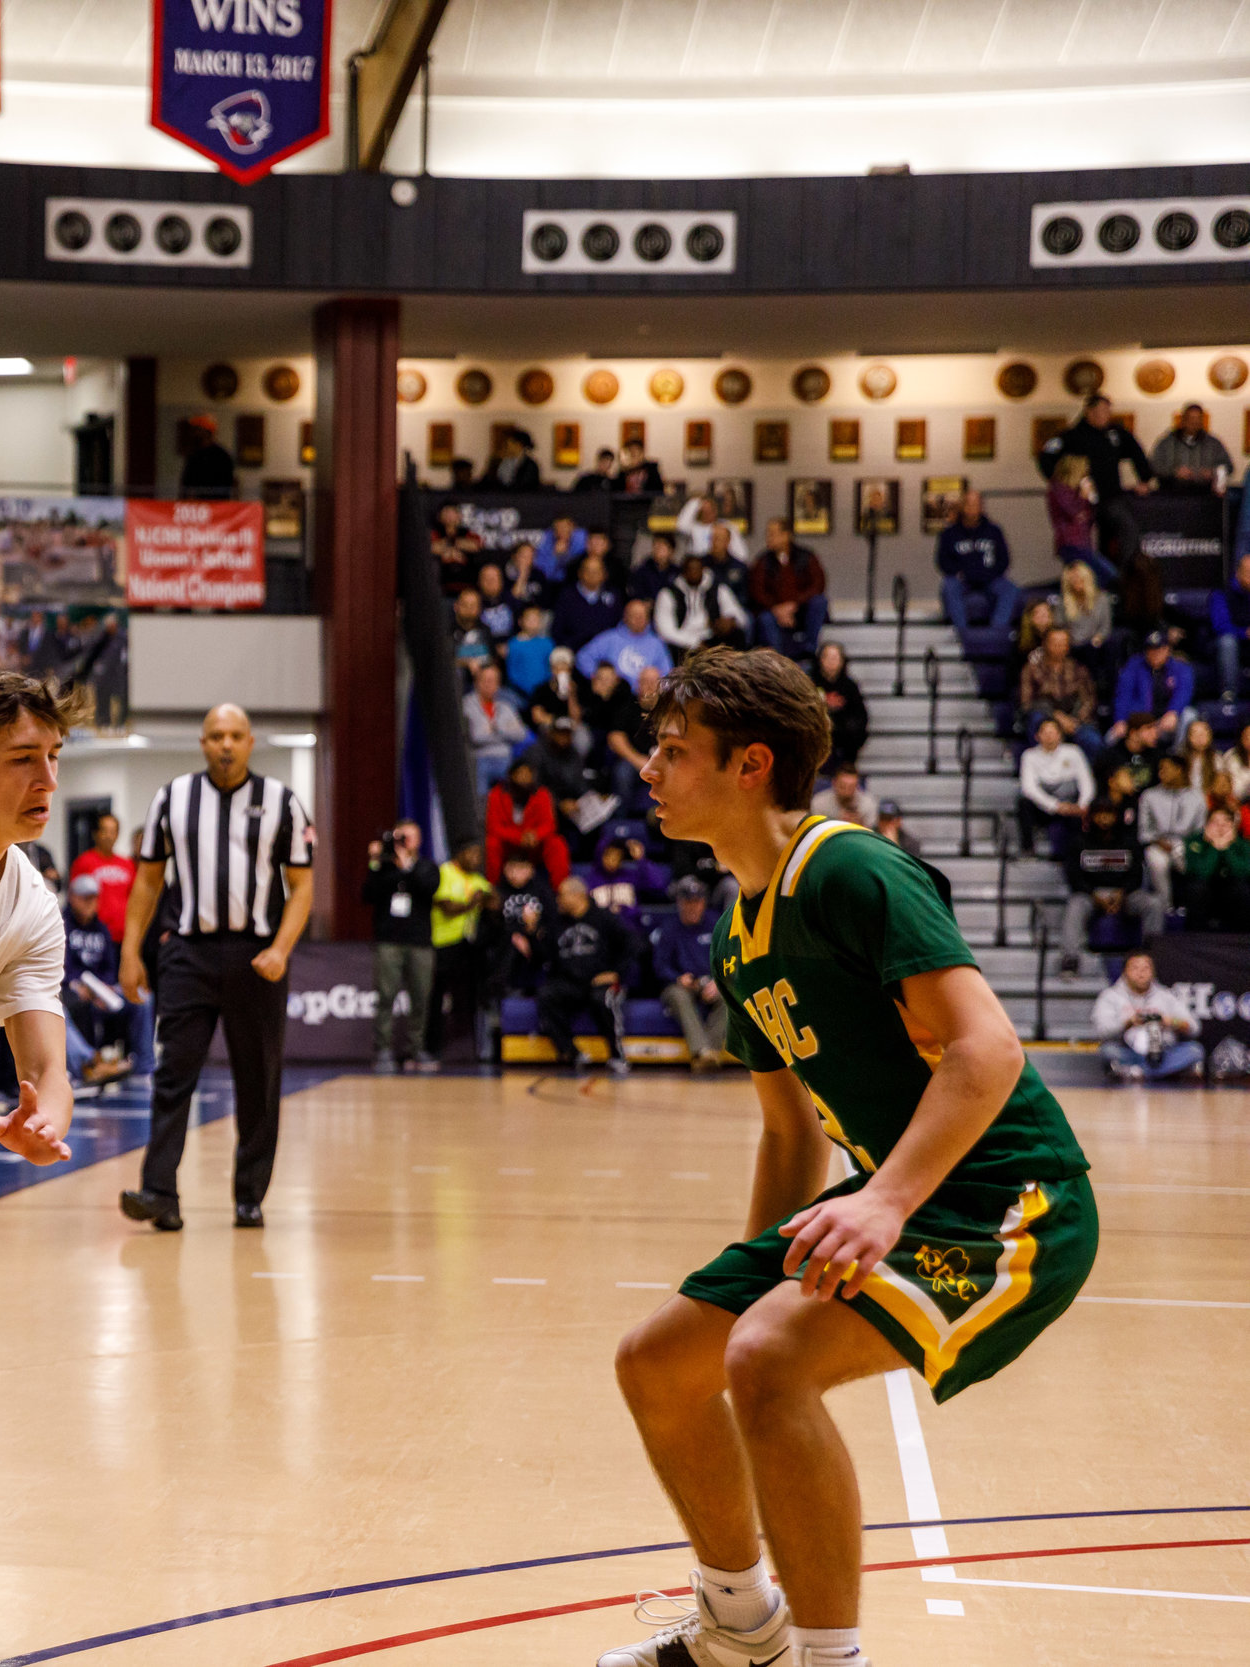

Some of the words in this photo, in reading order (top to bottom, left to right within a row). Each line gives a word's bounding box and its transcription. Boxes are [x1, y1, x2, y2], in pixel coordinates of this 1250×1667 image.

[191, 0, 303, 38] WINS
[174, 47, 243, 78] MARCH
[245, 52, 271, 82] 13,
[271, 54, 317, 82] 2017
[743, 977, 819, 1068] BC
